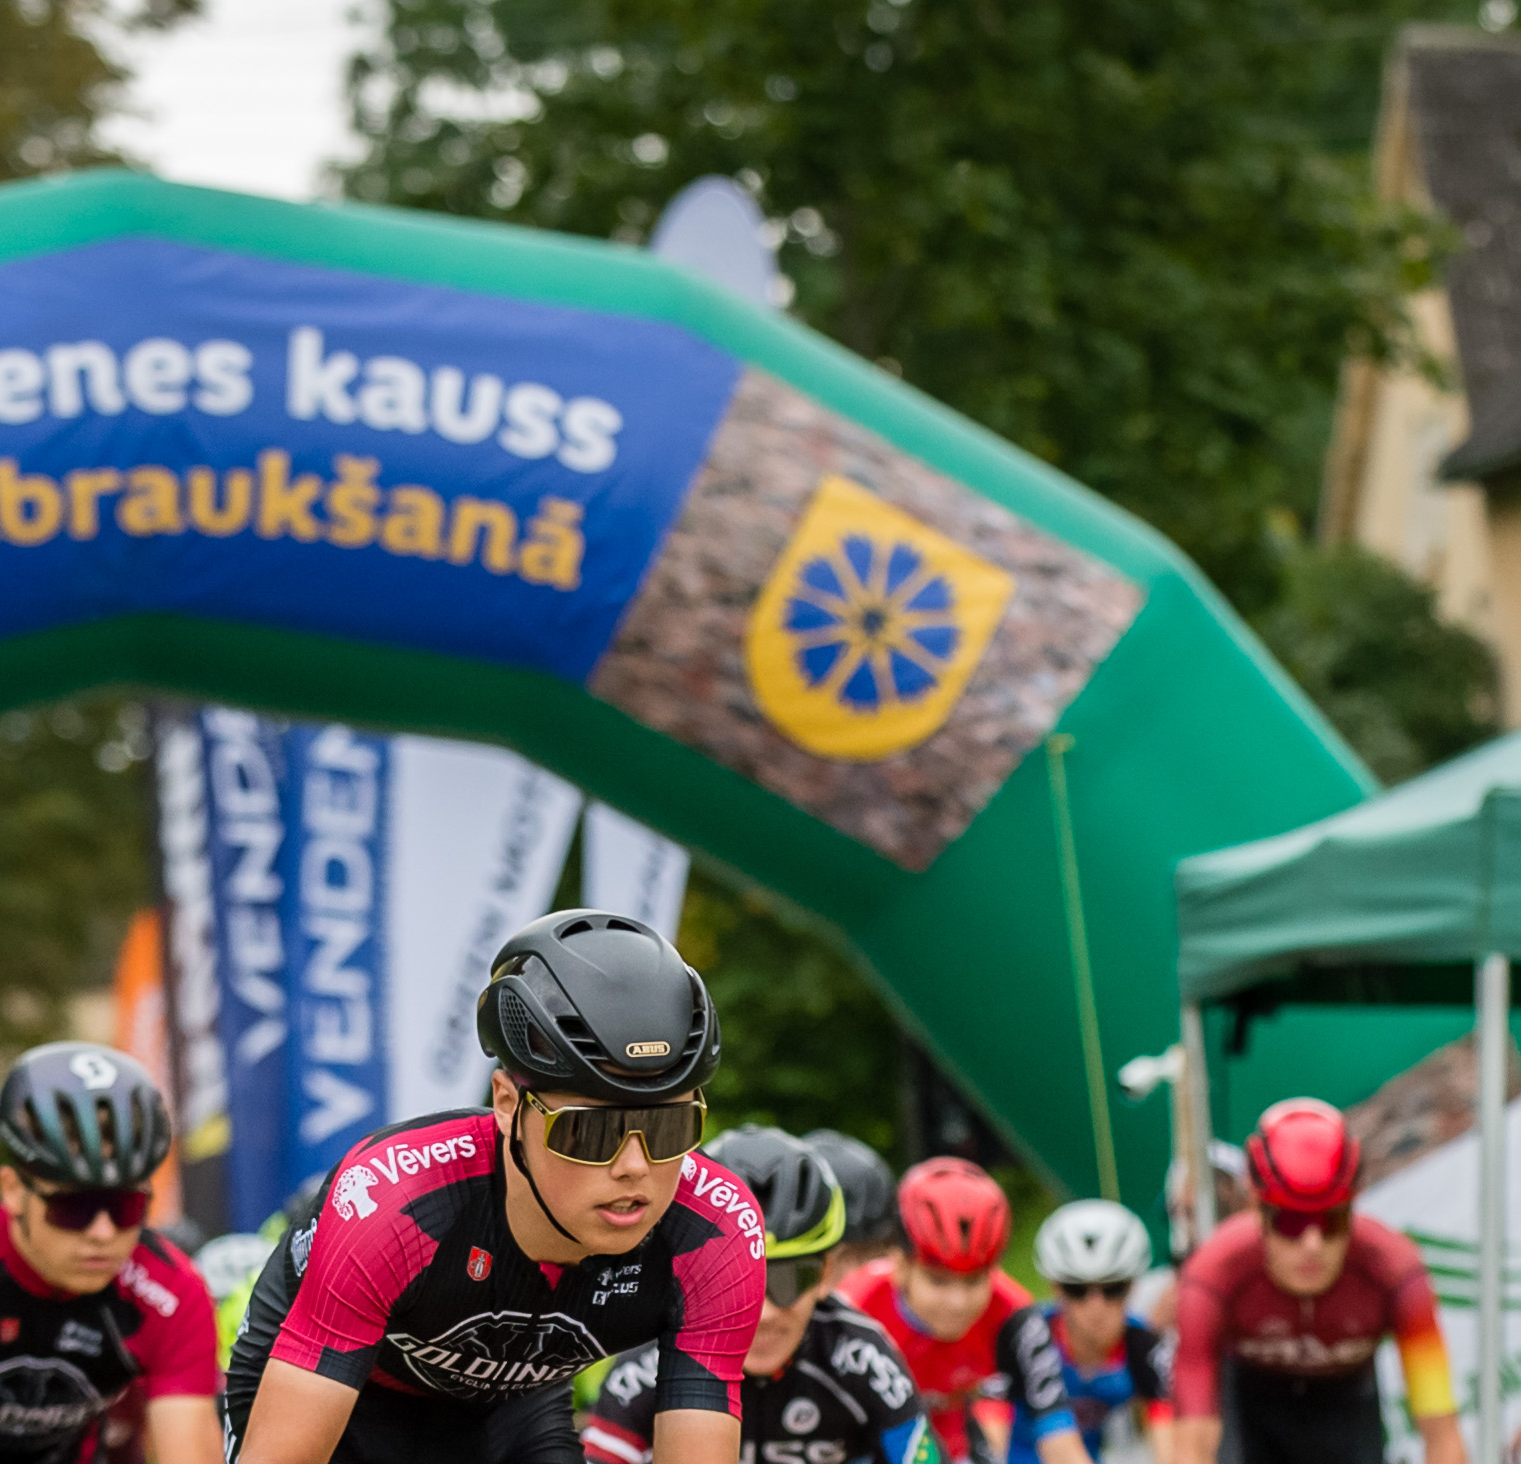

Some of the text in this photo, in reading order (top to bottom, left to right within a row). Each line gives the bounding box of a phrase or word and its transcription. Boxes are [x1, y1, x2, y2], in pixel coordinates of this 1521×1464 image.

[289, 326, 625, 474] kauss
[632, 1044, 666, 1055] ABUS
[370, 1134, 476, 1185] Vēvers
[693, 1167, 765, 1260] Vēvers
